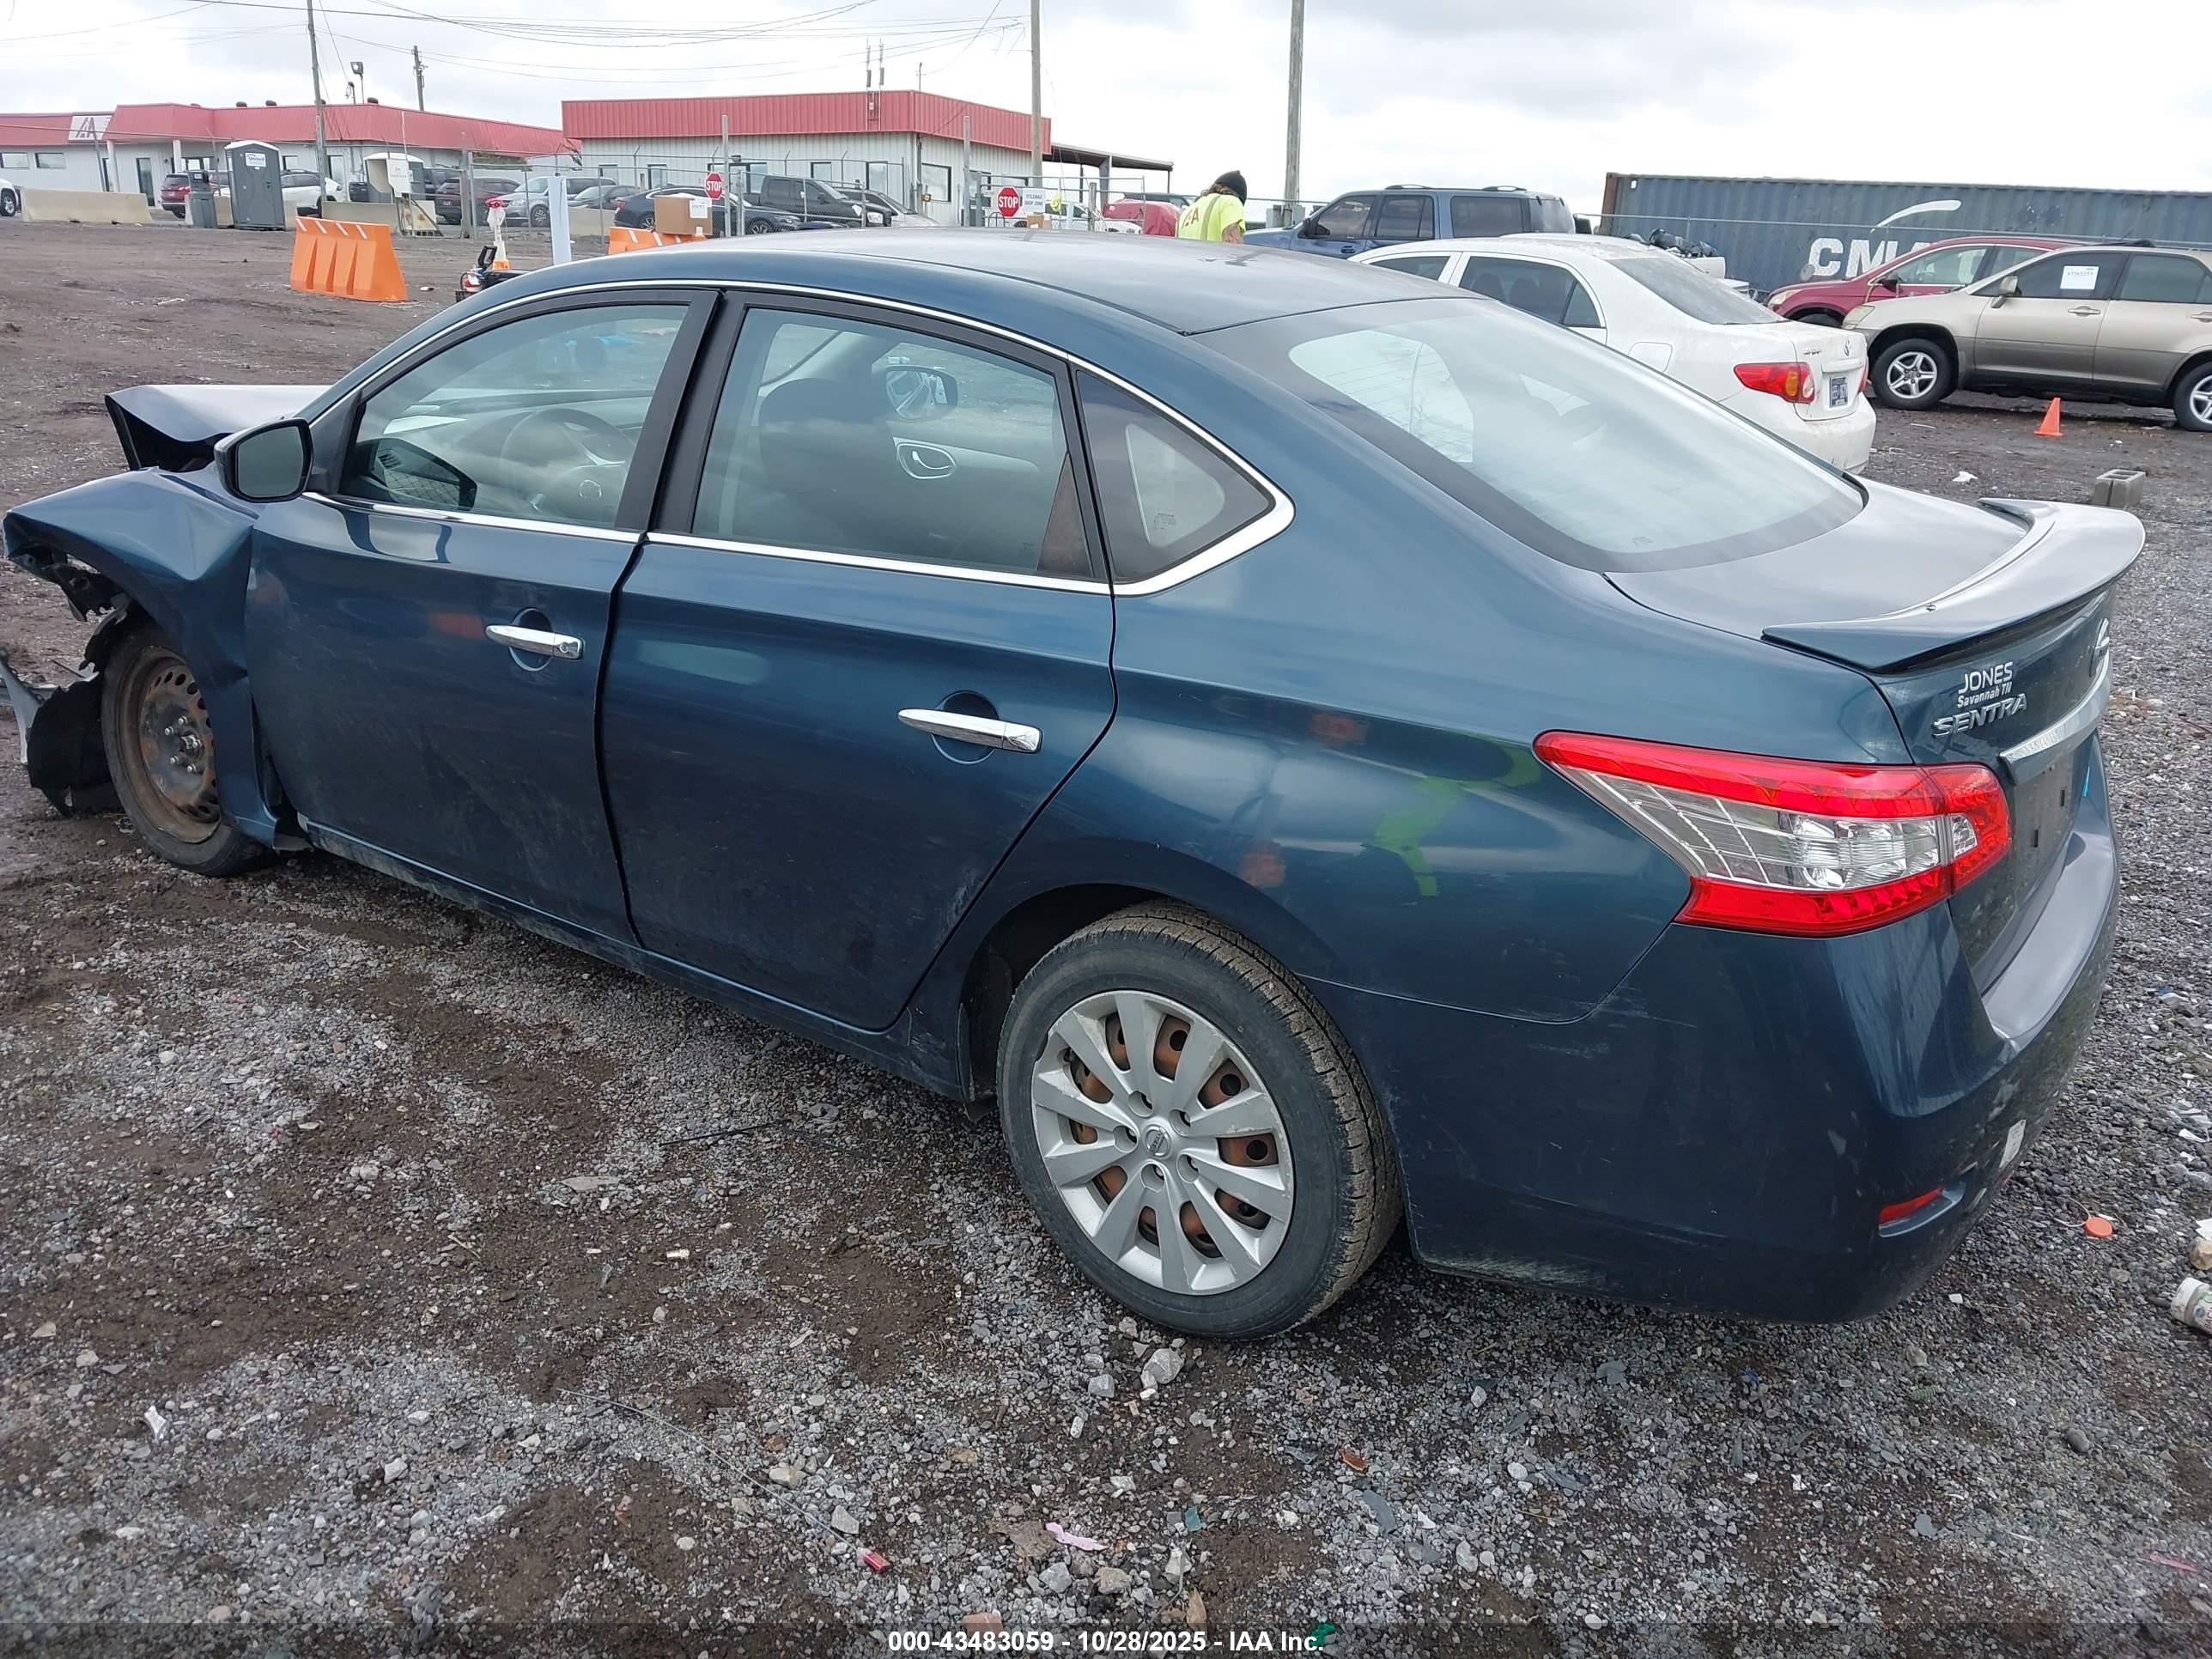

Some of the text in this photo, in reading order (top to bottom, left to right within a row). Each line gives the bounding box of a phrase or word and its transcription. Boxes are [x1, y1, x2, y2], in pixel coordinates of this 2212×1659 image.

[706, 180, 722, 192] STOP
[999, 196, 1018, 209] STOP
[1959, 661, 2013, 694] JONES
[1957, 681, 2013, 708] Savannah TN
[1932, 693, 2027, 737] SENTRA
